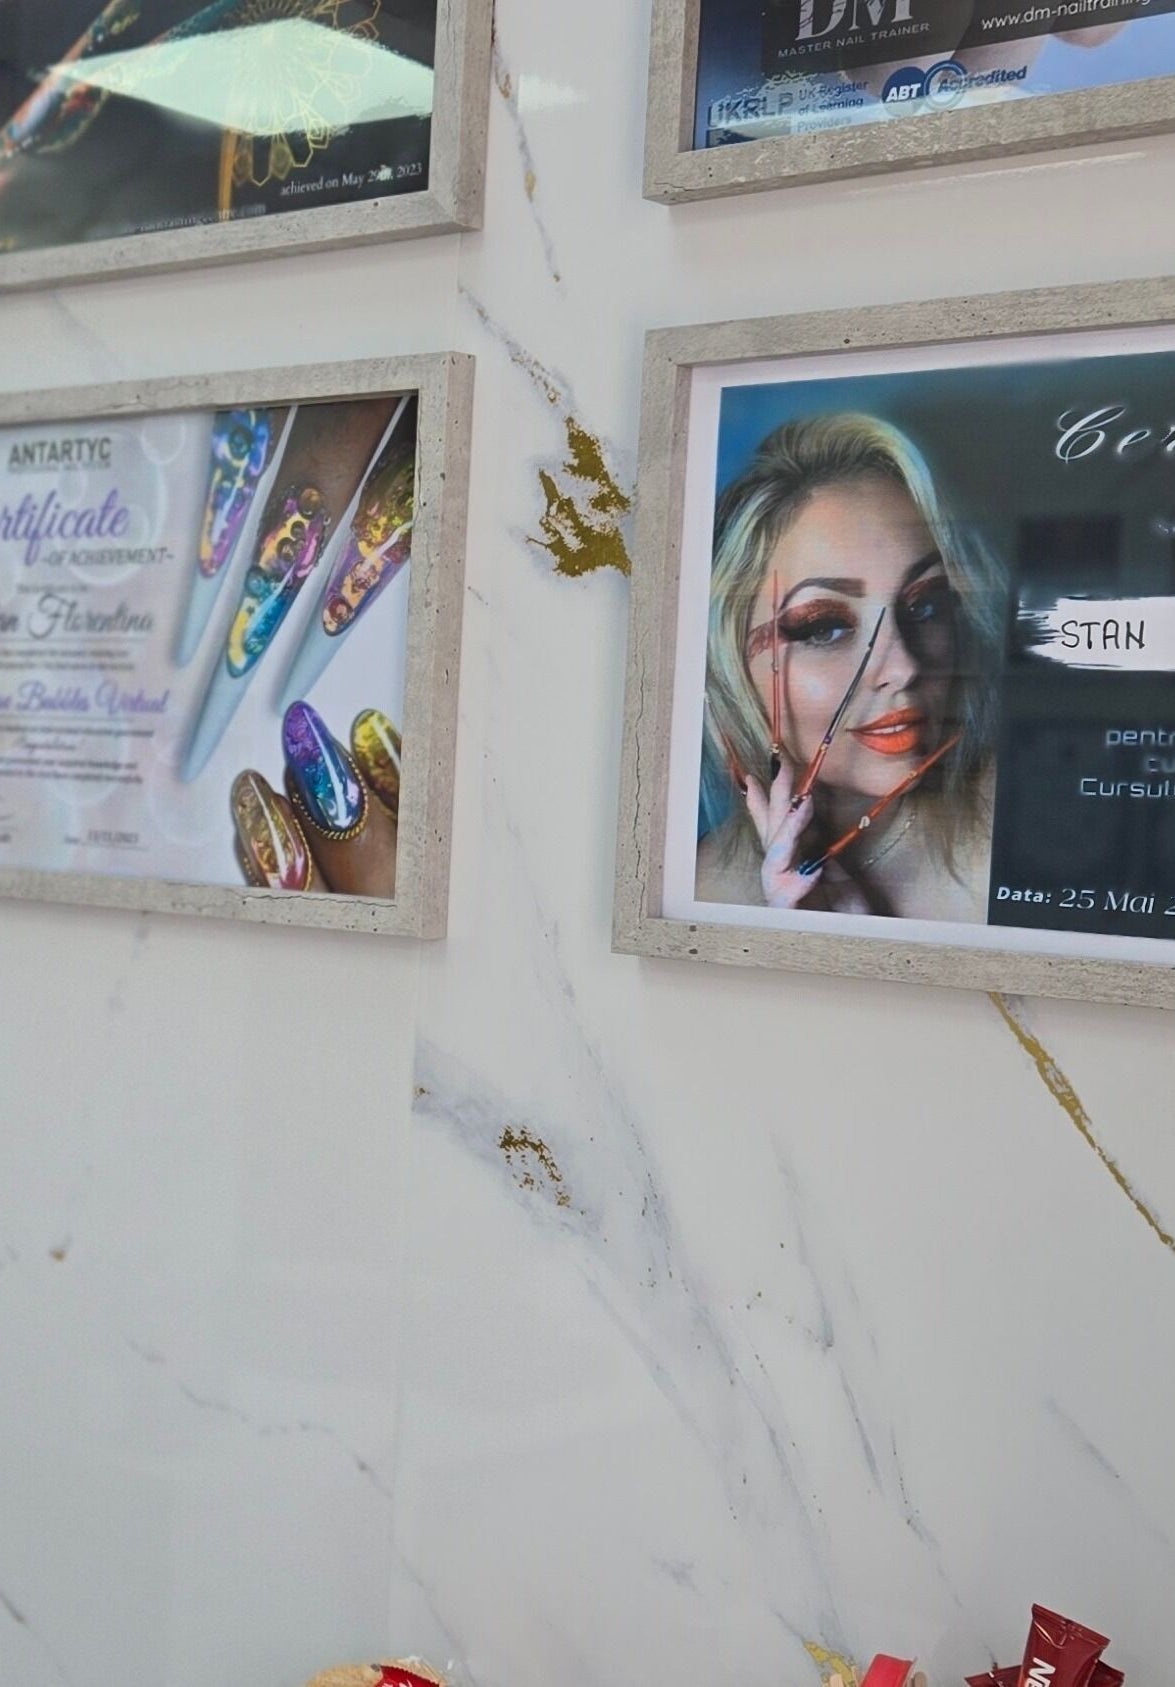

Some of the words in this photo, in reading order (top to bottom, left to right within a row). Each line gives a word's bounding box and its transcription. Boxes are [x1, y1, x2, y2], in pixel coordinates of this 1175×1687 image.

[777, 40, 832, 58] MASTER
[836, 34, 866, 49] NAIL
[871, 22, 931, 42] TRAINER
[886, 83, 922, 103] ABT
[937, 66, 1028, 94] Accredited
[280, 176, 323, 196] achieved
[325, 179, 339, 188] on
[342, 172, 365, 187] May
[397, 162, 423, 178] 2023
[9, 436, 112, 464] ANTARTYC
[1061, 619, 1145, 650] STAN
[1081, 778, 1175, 797] Cursul
[996, 886, 1052, 904] Data:
[1059, 887, 1095, 909] 25
[1104, 891, 1155, 914] Mai
